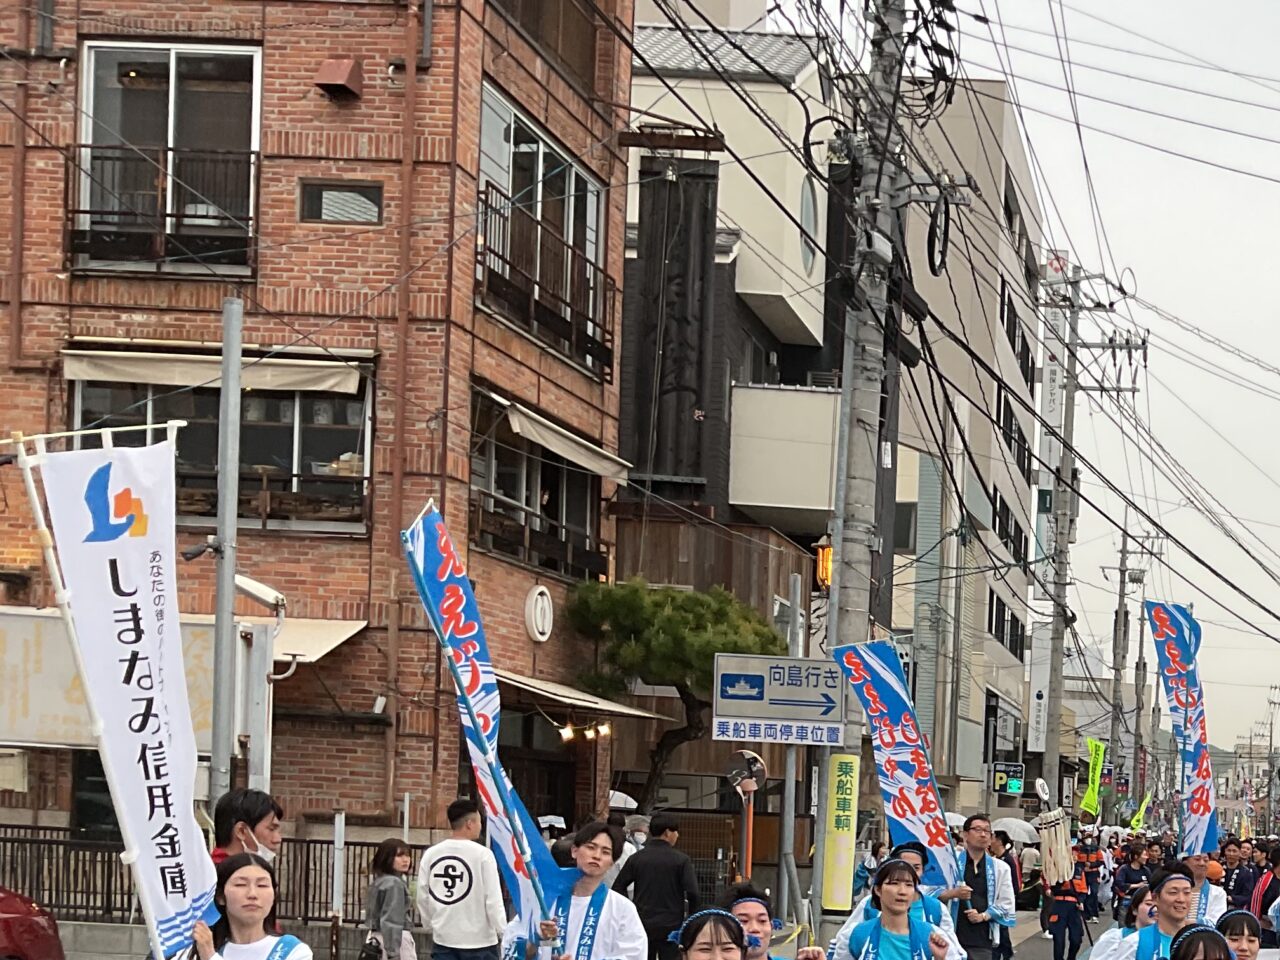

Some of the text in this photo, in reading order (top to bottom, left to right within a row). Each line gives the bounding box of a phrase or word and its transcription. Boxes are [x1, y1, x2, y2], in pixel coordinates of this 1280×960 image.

[768, 664, 839, 689] 向島行き
[107, 558, 188, 899] しまなみ信用金庫
[716, 720, 841, 744] 乗船車両停車位置
[994, 772, 1008, 790] P
